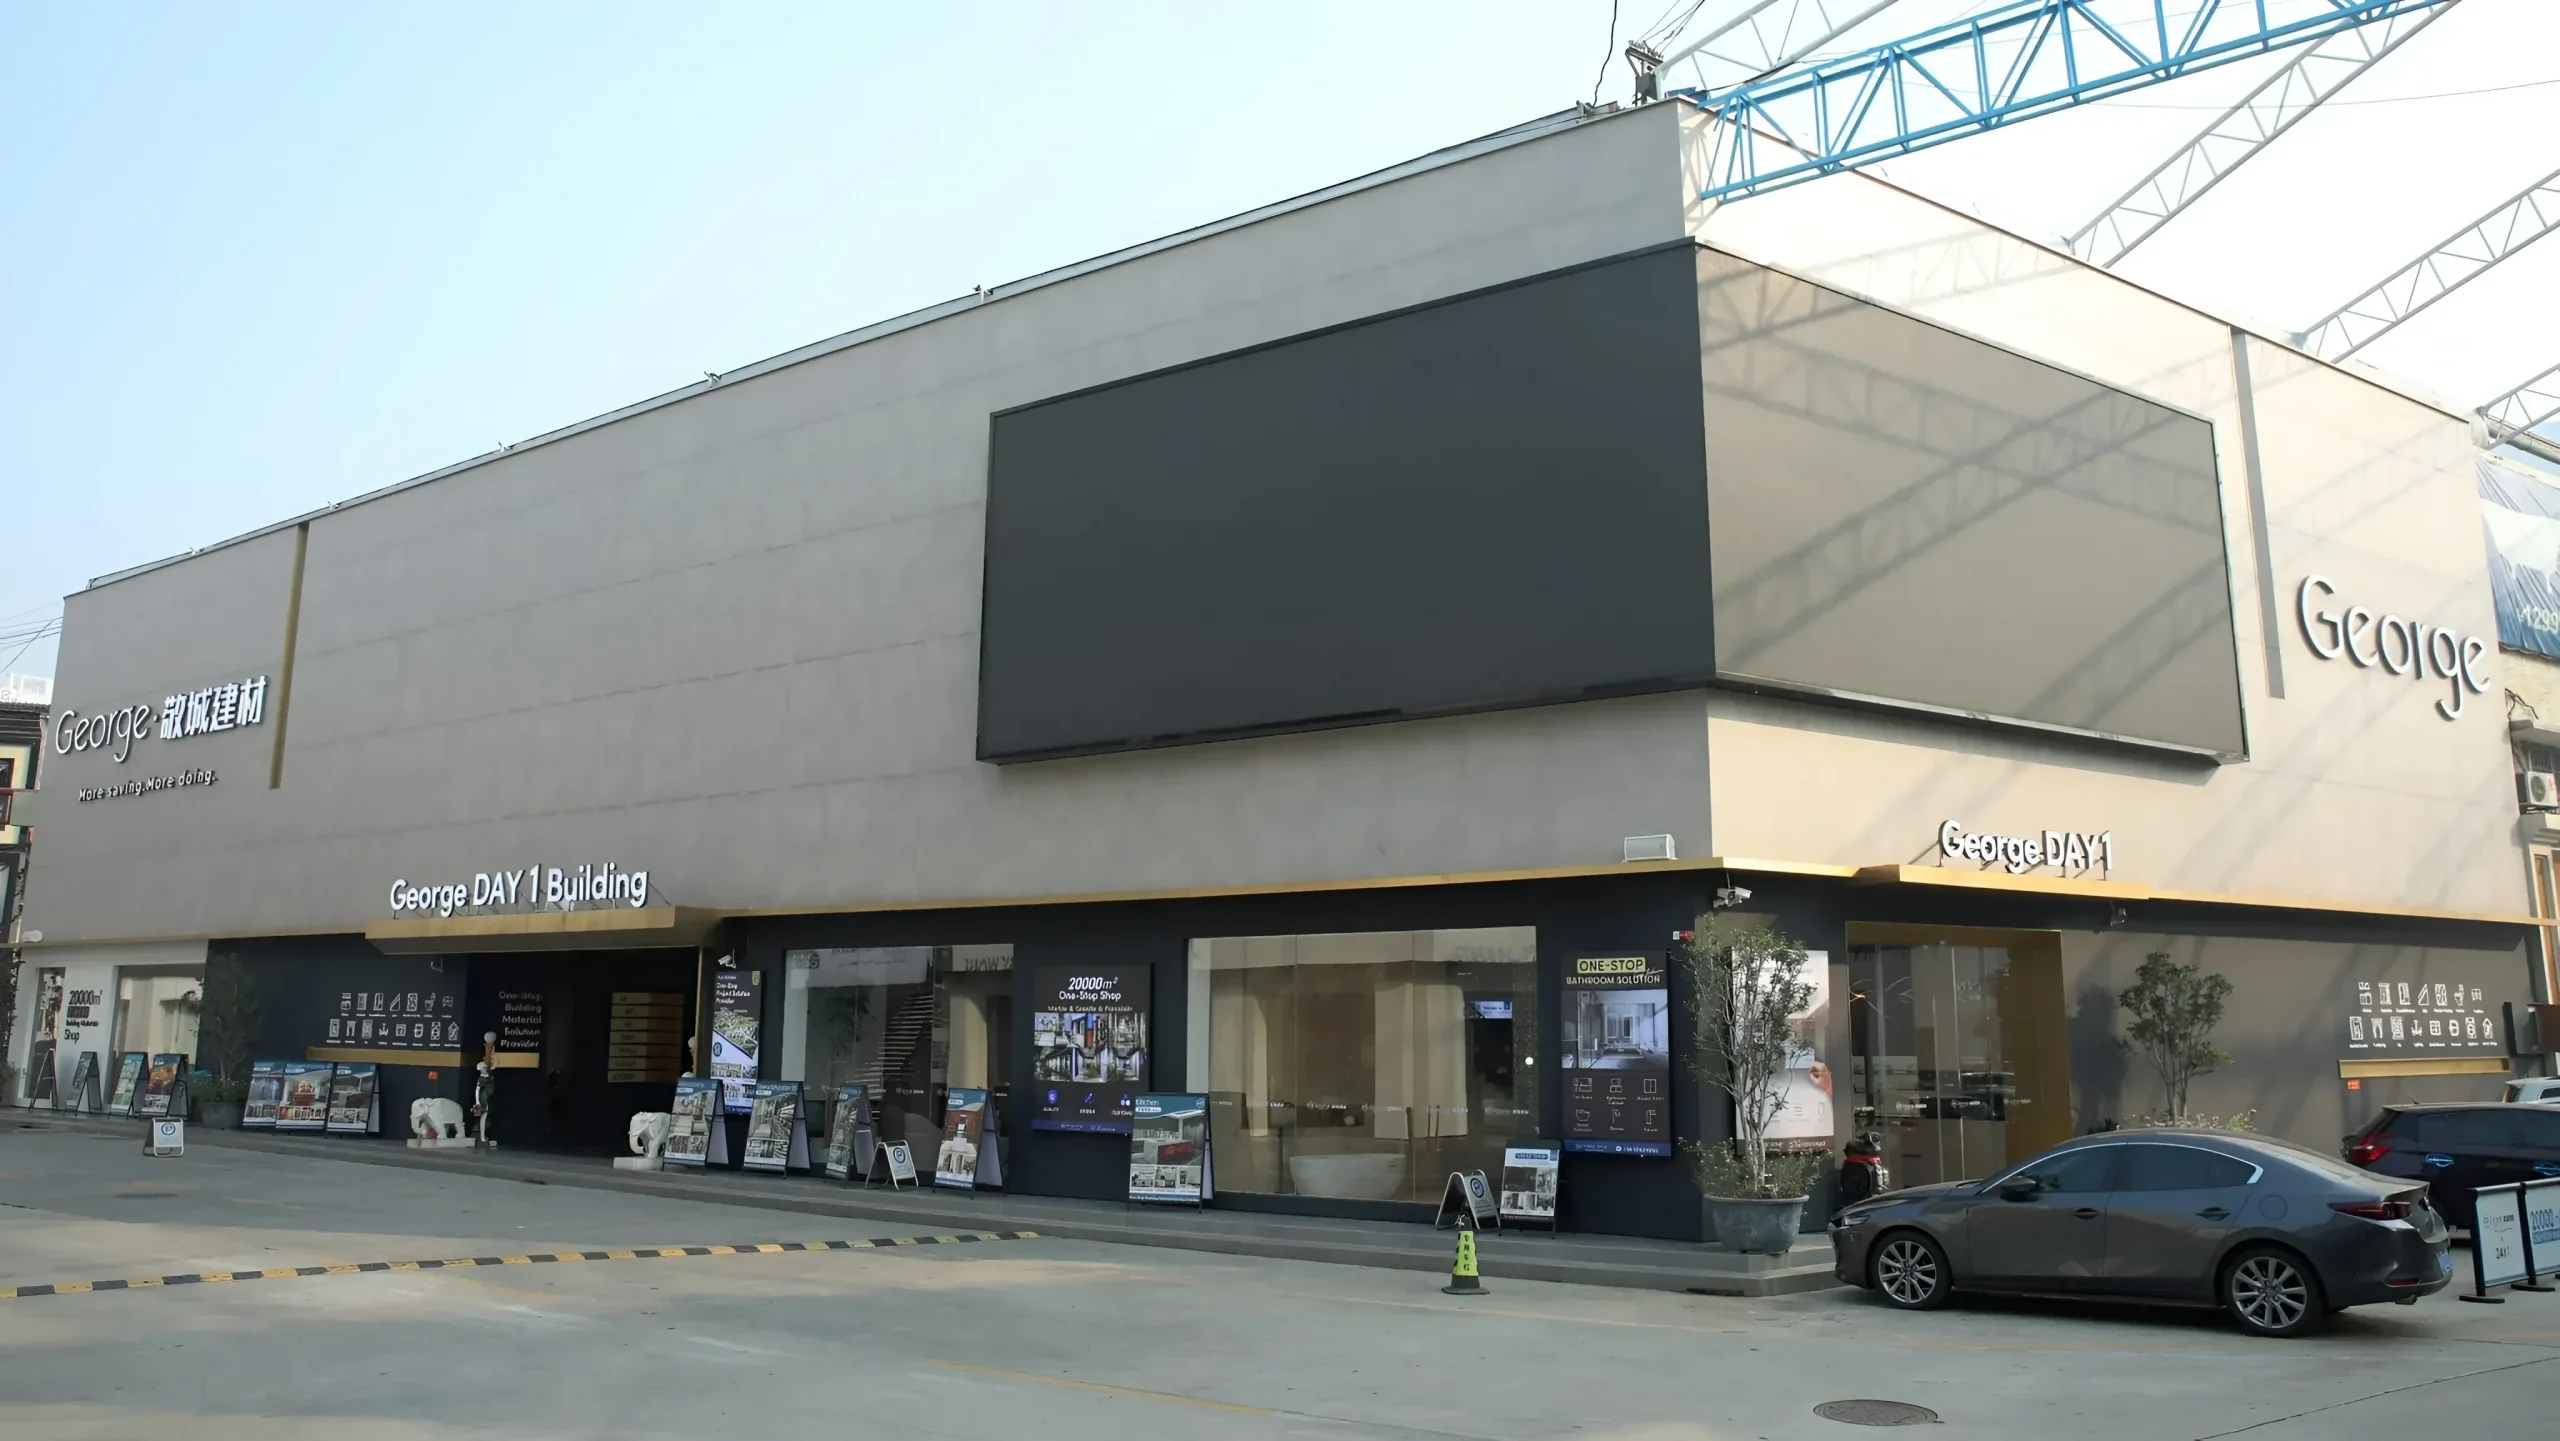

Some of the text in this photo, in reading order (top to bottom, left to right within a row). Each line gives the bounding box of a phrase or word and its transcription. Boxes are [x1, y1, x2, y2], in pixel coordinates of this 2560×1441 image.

[2297, 574, 2491, 722] George
[55, 675, 267, 764] George 敬城建材
[78, 788, 105, 802] More
[390, 861, 649, 918] George DAY 1 Building
[1579, 959, 1643, 971] ONE-STOP
[1566, 973, 1661, 985] BATHROOM SOLUTION
[1059, 990, 1122, 1002] One-Stop Shop
